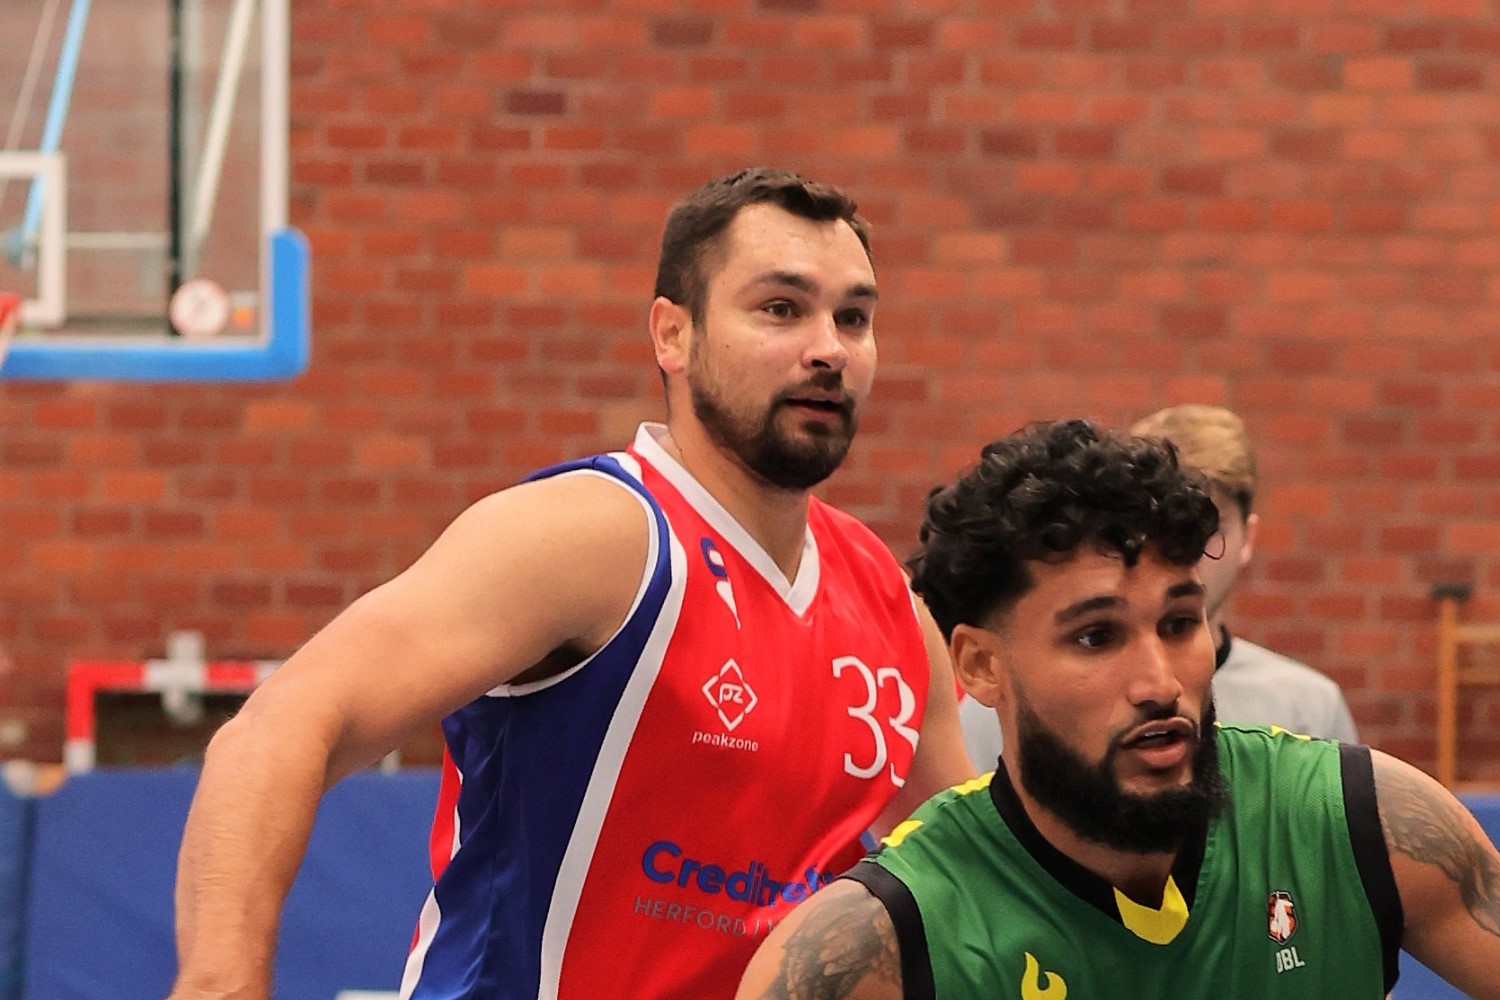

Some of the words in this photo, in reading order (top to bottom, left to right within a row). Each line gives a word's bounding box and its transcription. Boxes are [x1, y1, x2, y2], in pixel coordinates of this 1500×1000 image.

[692, 730, 759, 753] peakzone
[832, 654, 920, 788] 33
[634, 894, 748, 938] HERFORD
